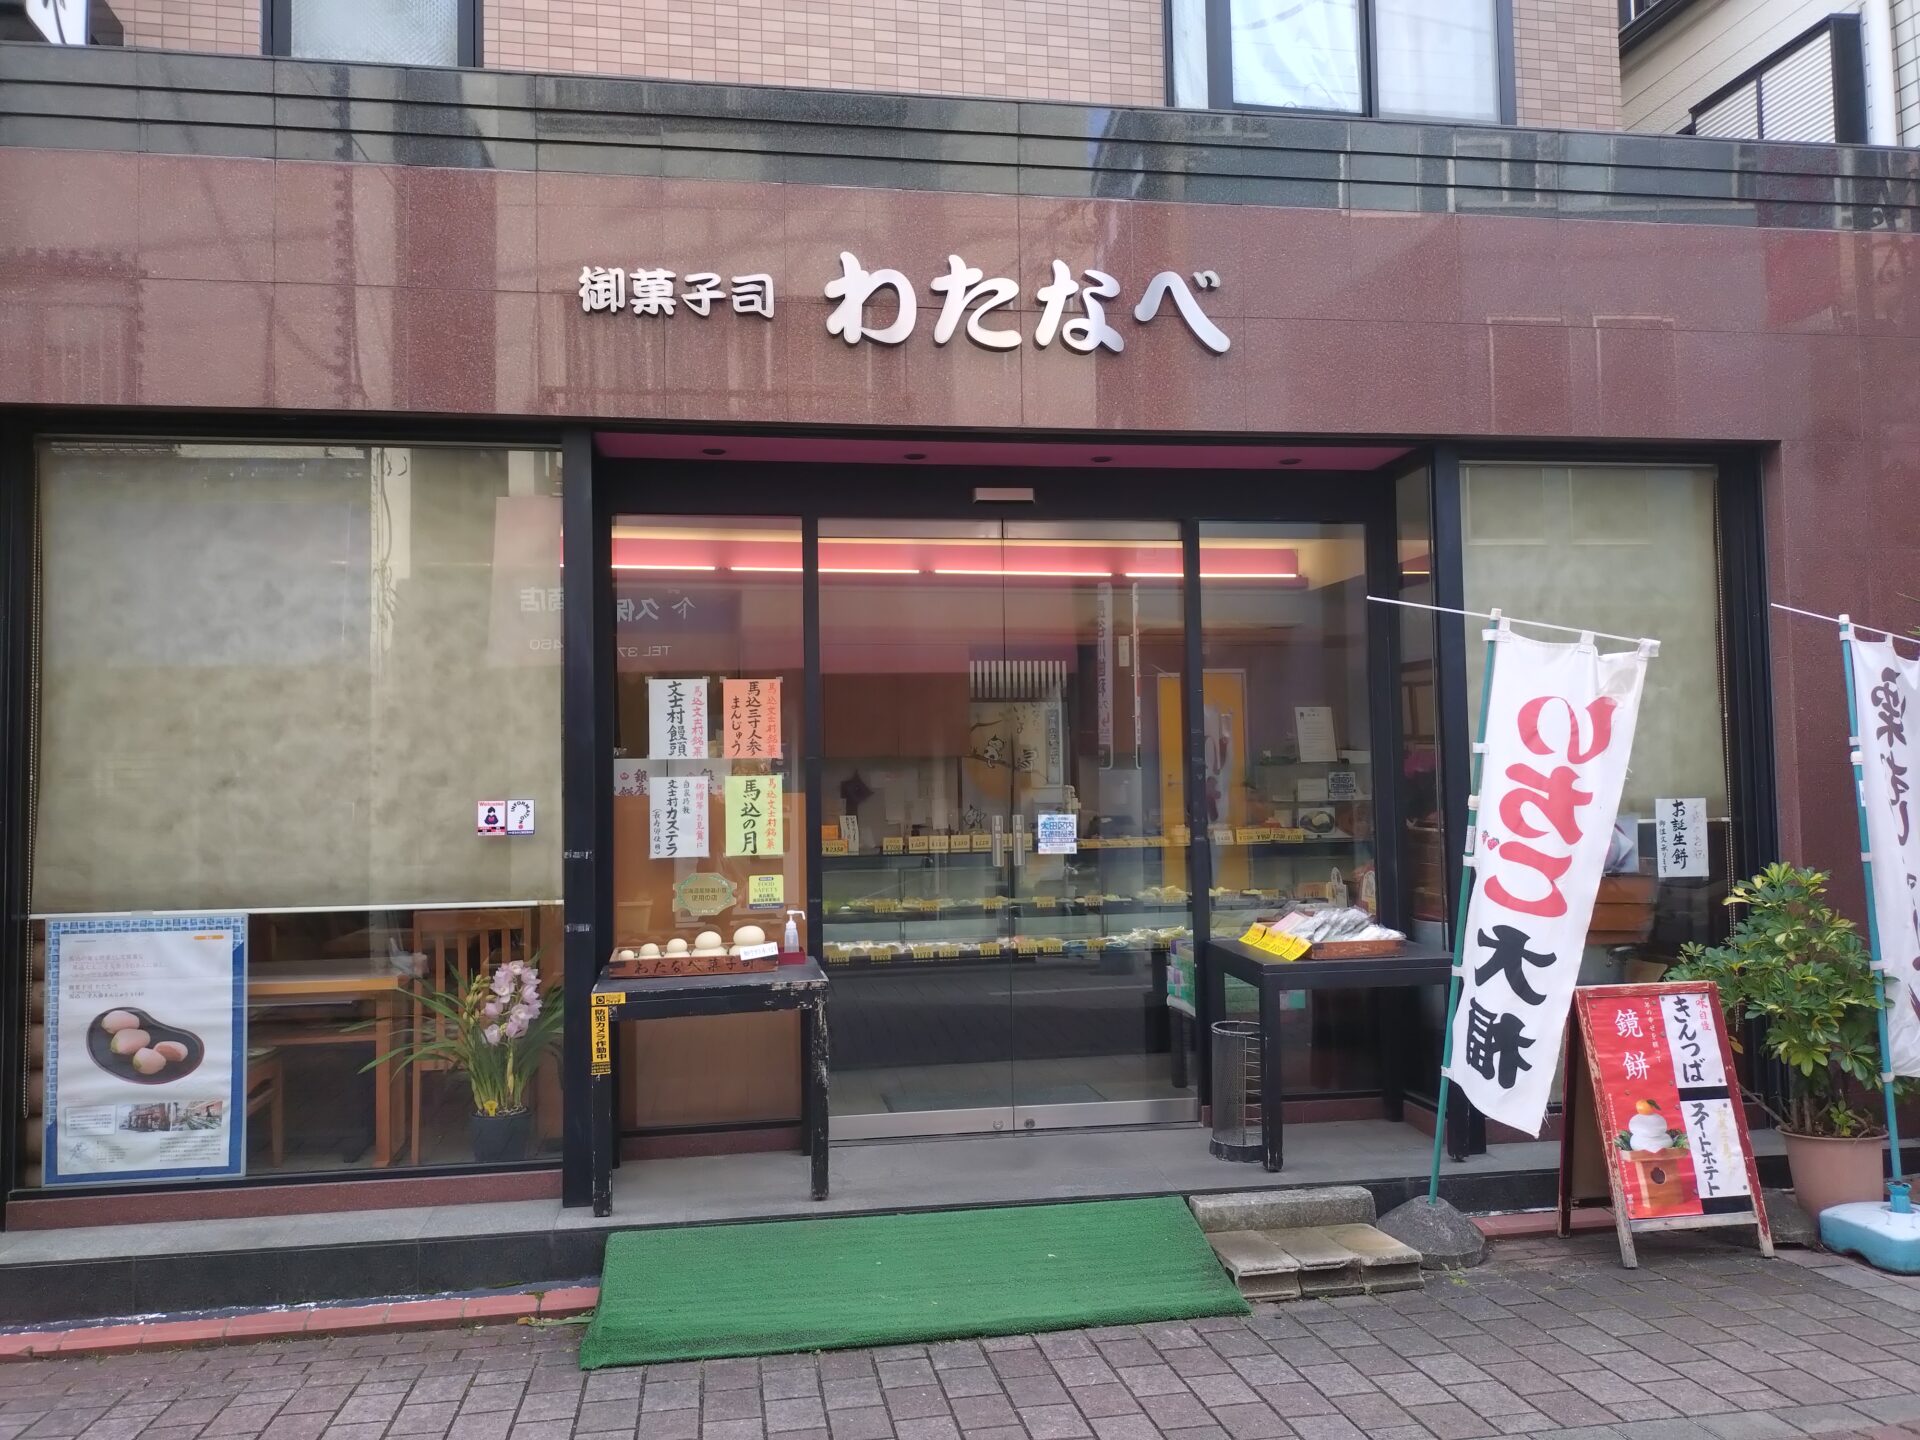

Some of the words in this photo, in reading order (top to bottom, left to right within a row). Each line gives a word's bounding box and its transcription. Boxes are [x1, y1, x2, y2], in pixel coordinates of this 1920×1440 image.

[578, 265, 776, 319] 御菓子司
[824, 250, 1231, 354] わたなべ
[667, 681, 687, 757] 文士村饅頭
[731, 695, 743, 757] まんじゅう
[746, 681, 762, 757] 馬込三寸人参
[666, 779, 679, 857] 文士村カステラ
[741, 779, 762, 855] 馬込の月
[1671, 799, 1689, 870] お誕生餅
[1614, 1008, 1650, 1081] 鏡餅
[1673, 995, 1706, 1083] きんつば
